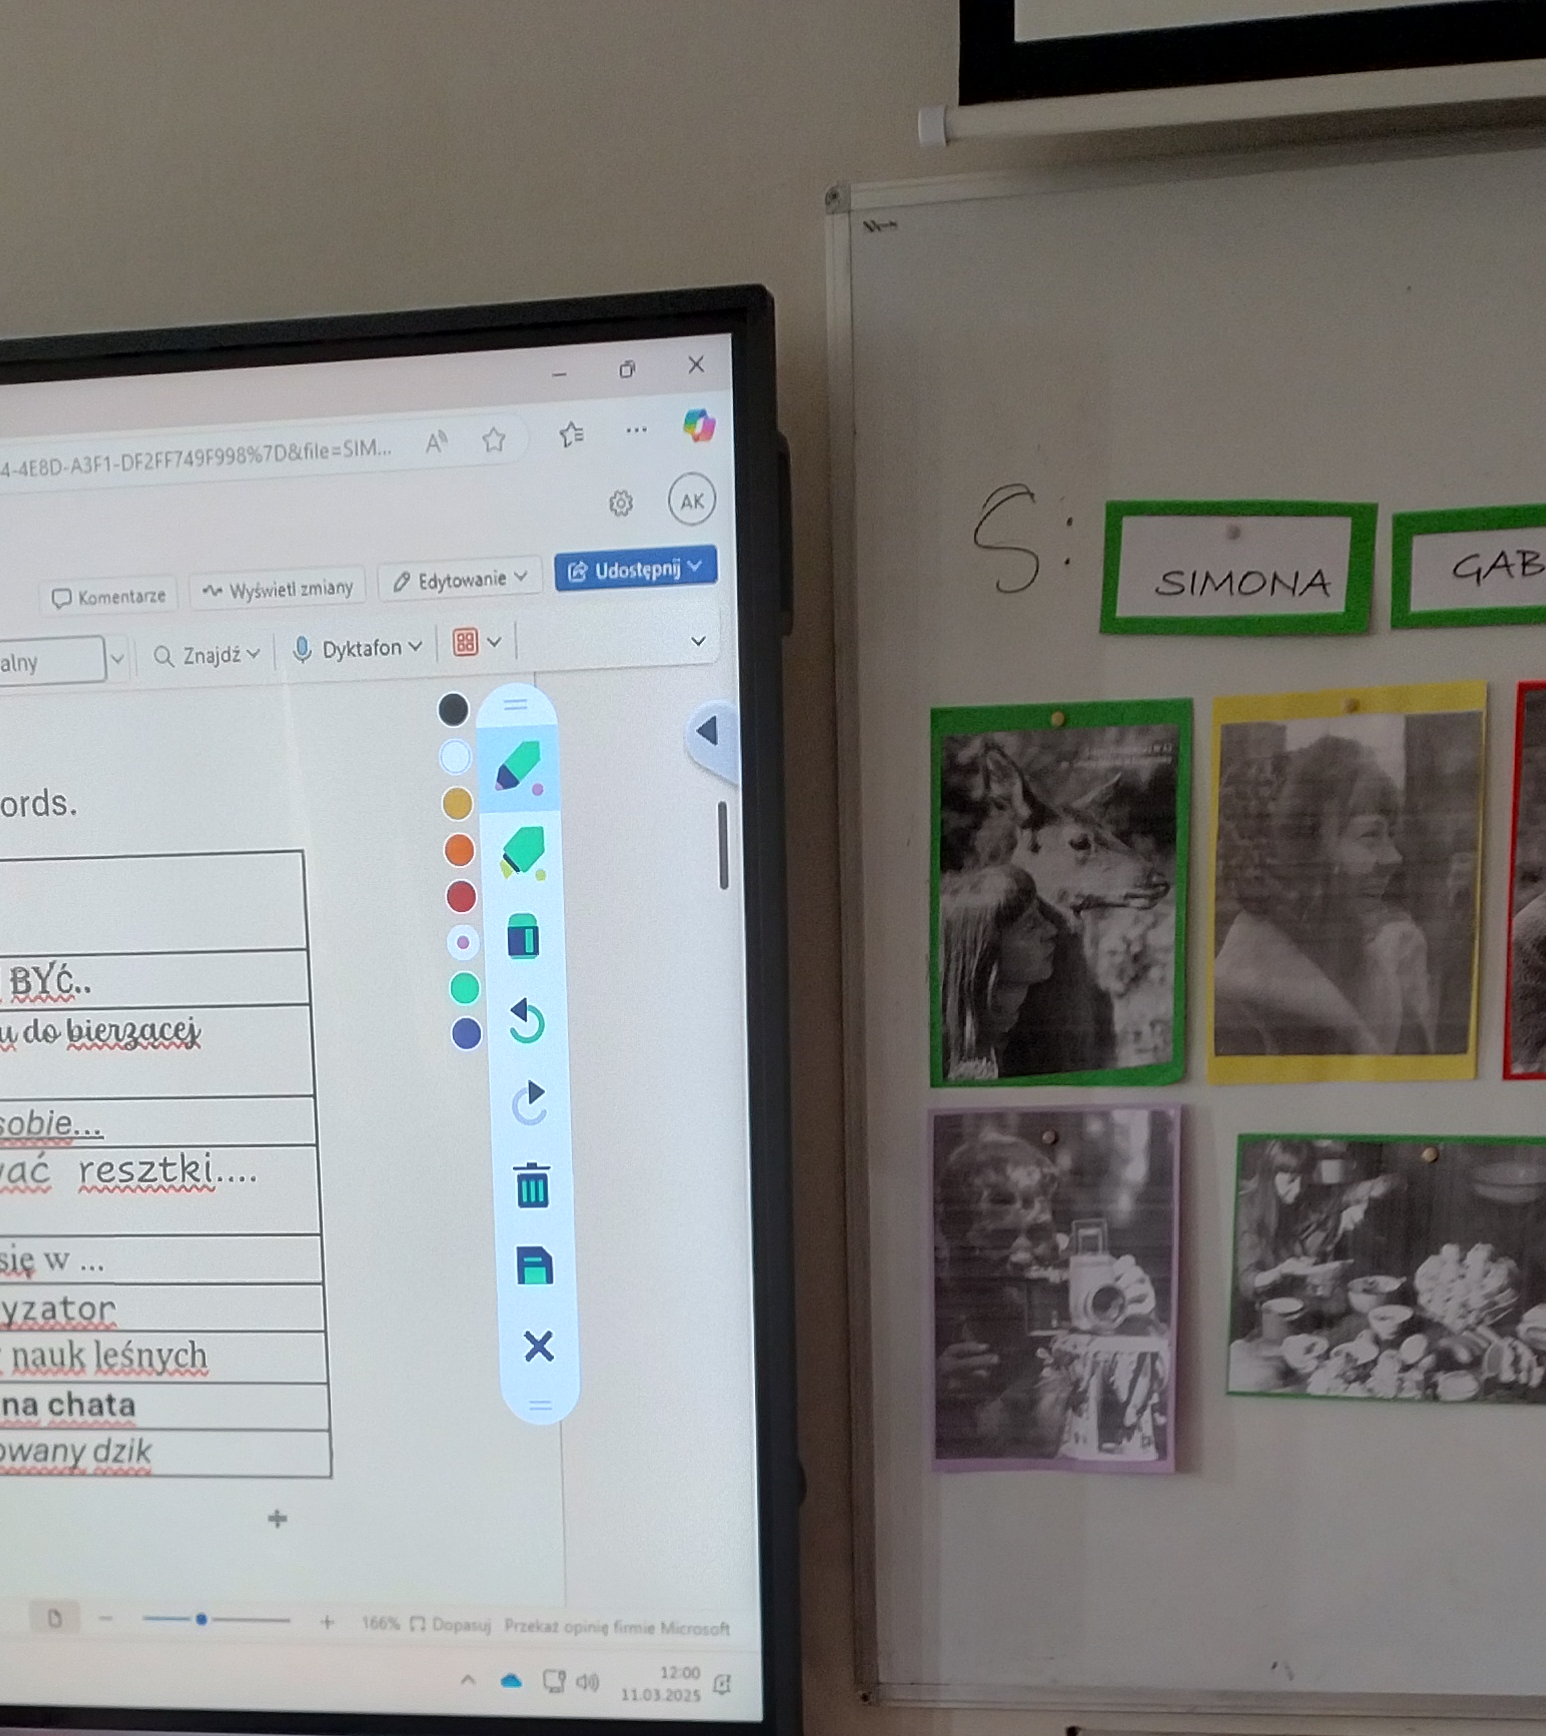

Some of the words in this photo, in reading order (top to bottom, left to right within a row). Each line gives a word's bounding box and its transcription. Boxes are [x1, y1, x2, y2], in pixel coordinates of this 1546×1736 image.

[680, 493, 706, 511] AK
[596, 557, 683, 581] Udostępnij
[229, 580, 297, 604] Wyświetl
[300, 580, 355, 600] zmiany
[418, 570, 508, 593] Edytowanie
[1154, 567, 1331, 599] SIMONA
[78, 589, 167, 606] Komentarze
[183, 645, 241, 667] Znajdź
[323, 637, 403, 661] Dyktafon
[22, 1012, 62, 1045] do
[44, 1250, 71, 1271] w
[11, 1338, 88, 1371] nauk
[94, 1337, 209, 1376] leśnych
[47, 1389, 137, 1418] chata
[93, 1434, 155, 1465] dzik
[432, 1616, 493, 1638] Dopasuj
[505, 1617, 559, 1634] Przekaż
[613, 1620, 656, 1636] firmie
[660, 1620, 731, 1637] Microsoft
[661, 1666, 702, 1681] 12:00
[621, 1688, 702, 1703] 11.03.2025
